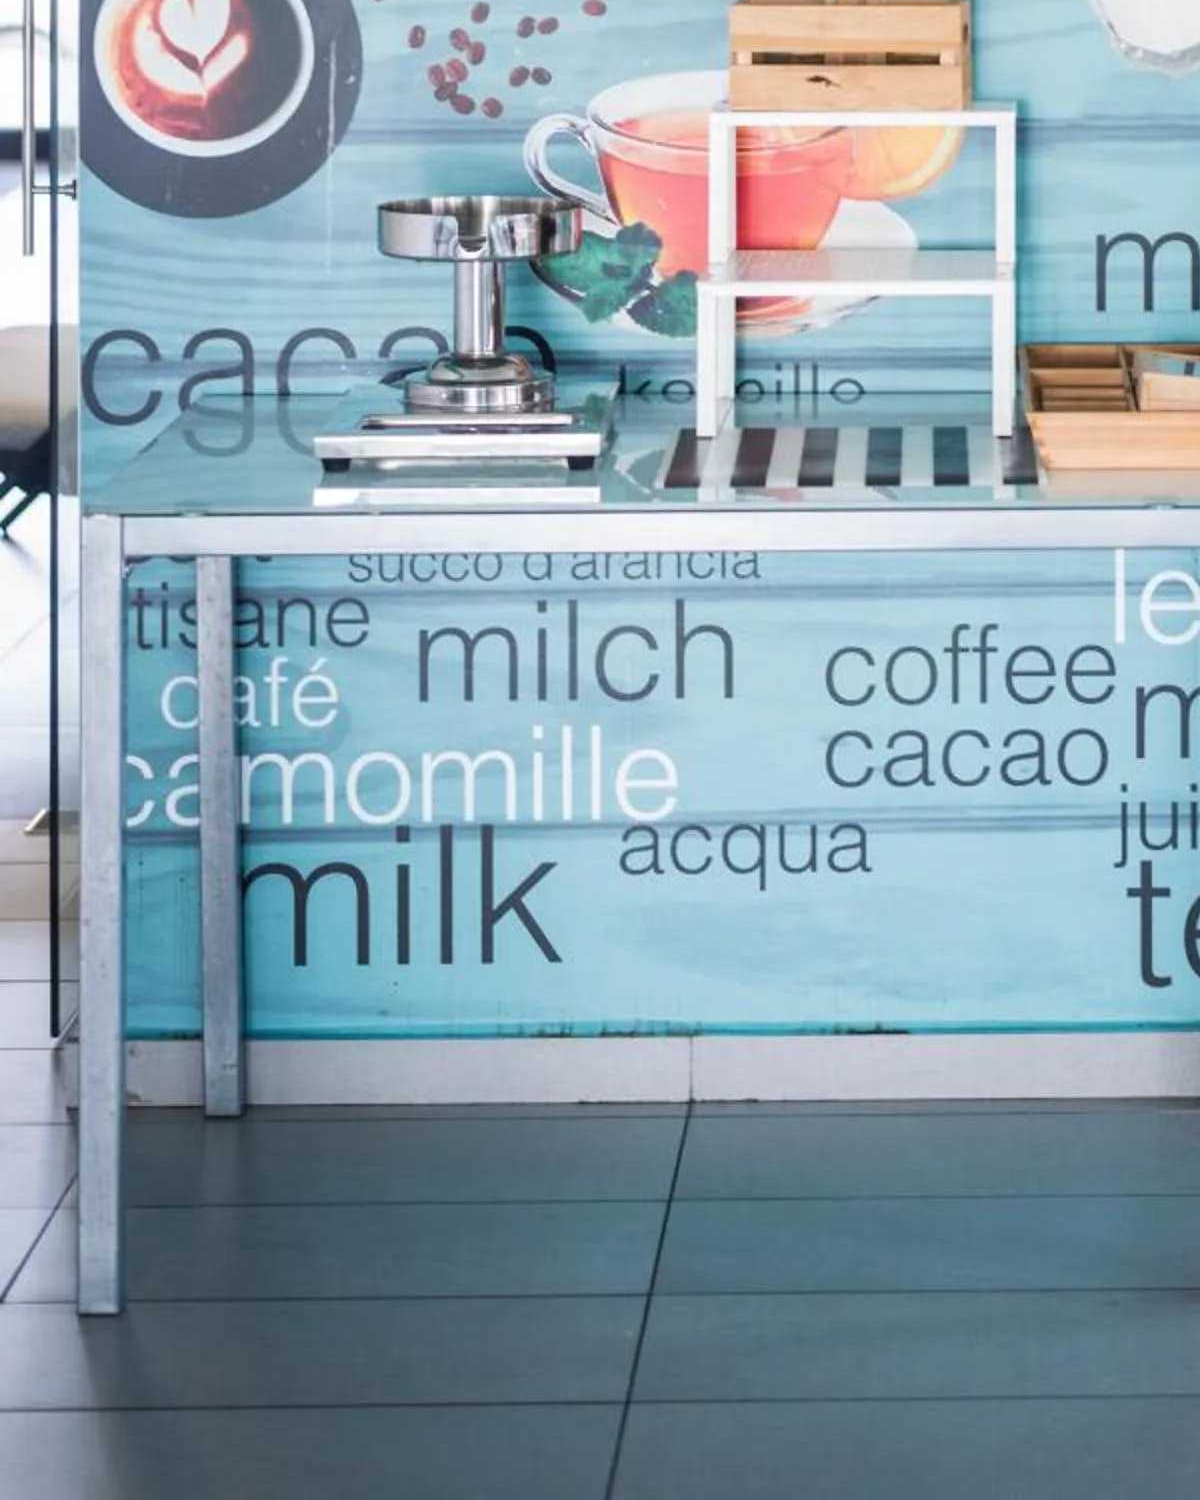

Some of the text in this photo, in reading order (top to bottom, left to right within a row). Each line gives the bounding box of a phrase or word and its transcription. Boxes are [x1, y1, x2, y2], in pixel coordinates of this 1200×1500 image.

[347, 552, 762, 582] succo darancia
[131, 582, 371, 650] tisane
[418, 598, 736, 703] milch
[824, 622, 1117, 706] coffee
[824, 727, 1110, 789] cacao
[619, 820, 874, 892] acqua
[243, 824, 564, 968] milk
